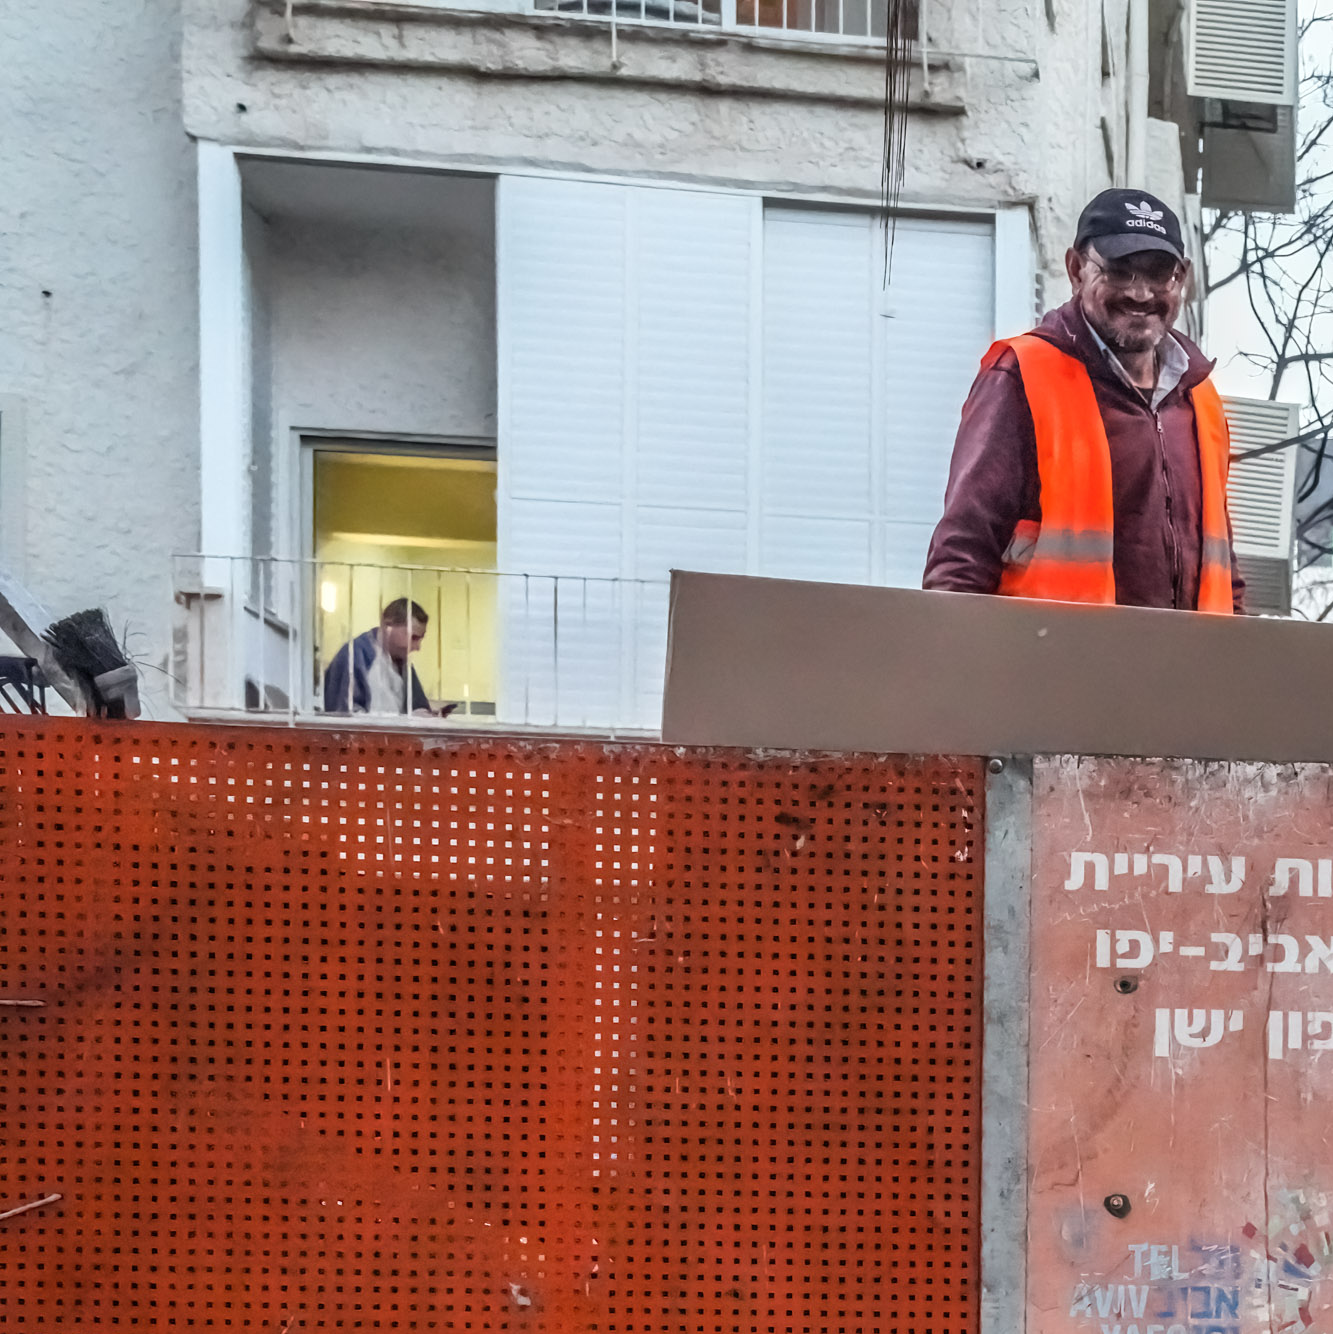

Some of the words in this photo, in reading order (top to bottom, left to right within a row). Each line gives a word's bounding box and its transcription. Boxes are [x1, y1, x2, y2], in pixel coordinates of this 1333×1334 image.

[1126, 219, 1167, 234] adidas
[1064, 851, 1246, 894] עיריית
[1154, 1007, 1245, 1058] ישן
[1127, 1243, 1190, 1280] TEL
[1069, 1284, 1150, 1319] AVIV
